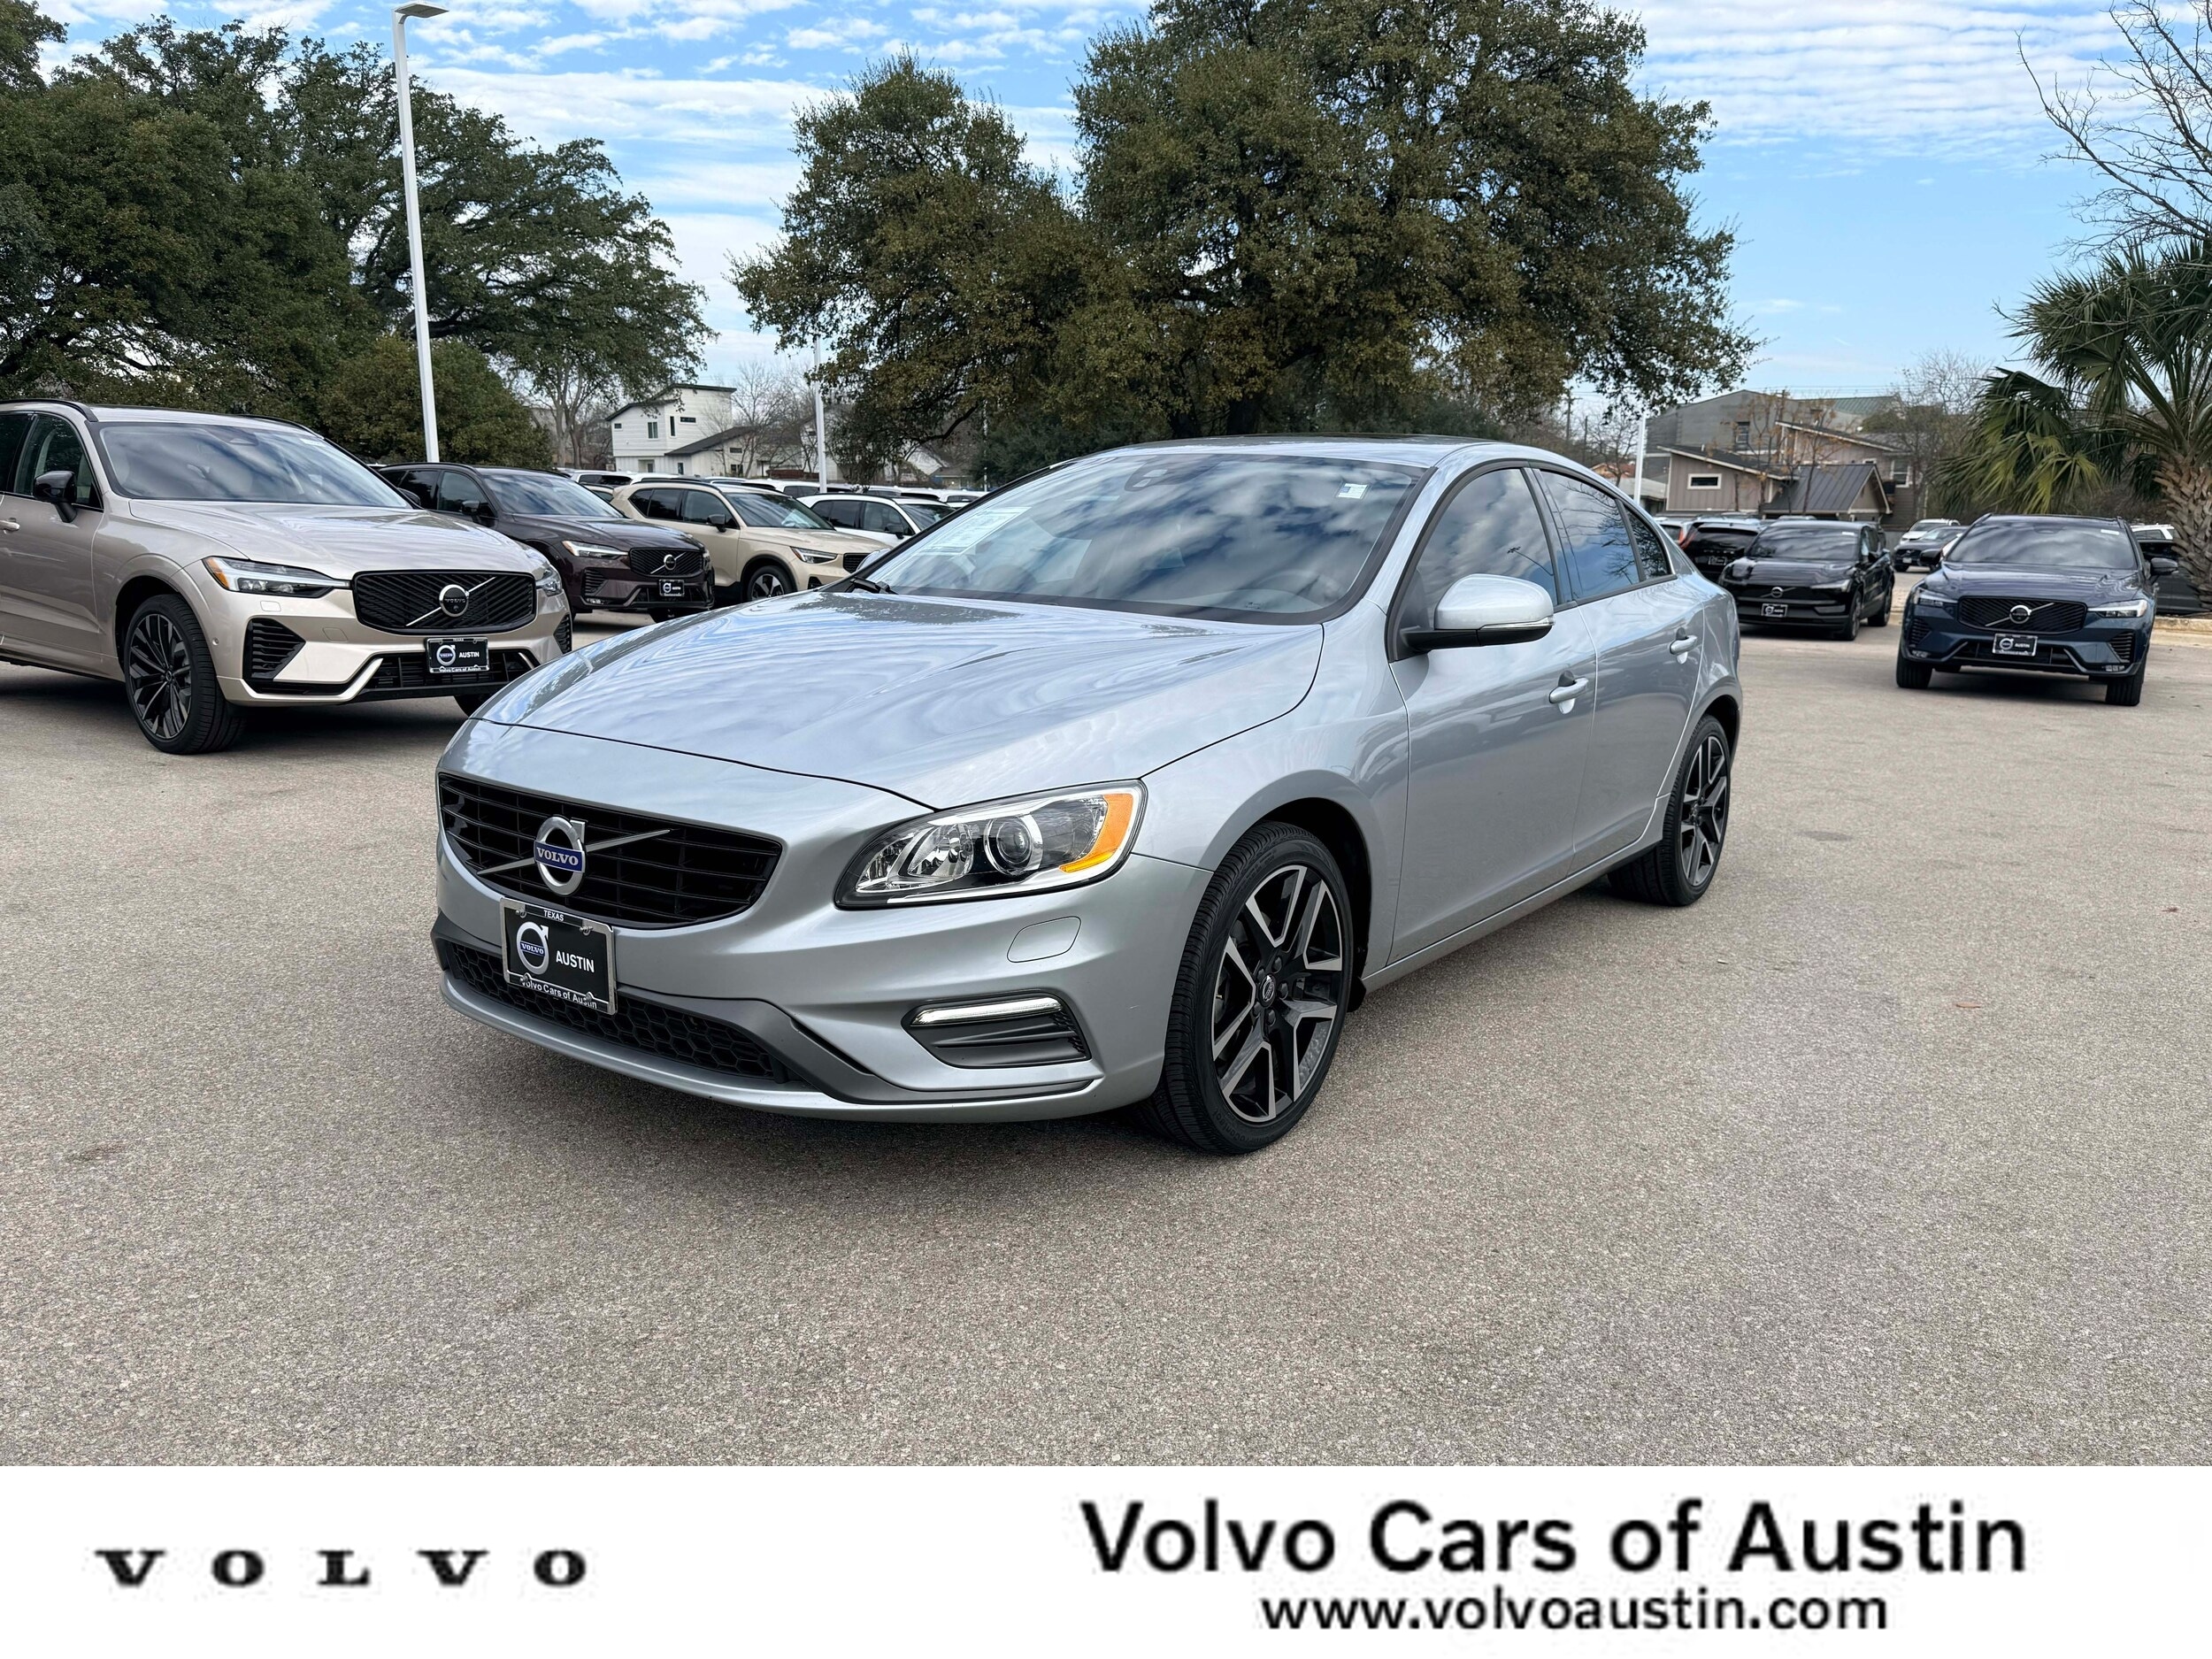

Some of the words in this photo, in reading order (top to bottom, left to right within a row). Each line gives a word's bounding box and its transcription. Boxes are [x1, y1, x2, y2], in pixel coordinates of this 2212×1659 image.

[536, 847, 579, 866] VOLVO
[543, 910, 564, 921] TEXAS
[520, 942, 544, 955] VOLVO
[556, 950, 595, 973] AUSTIN
[542, 984, 562, 997] Cars
